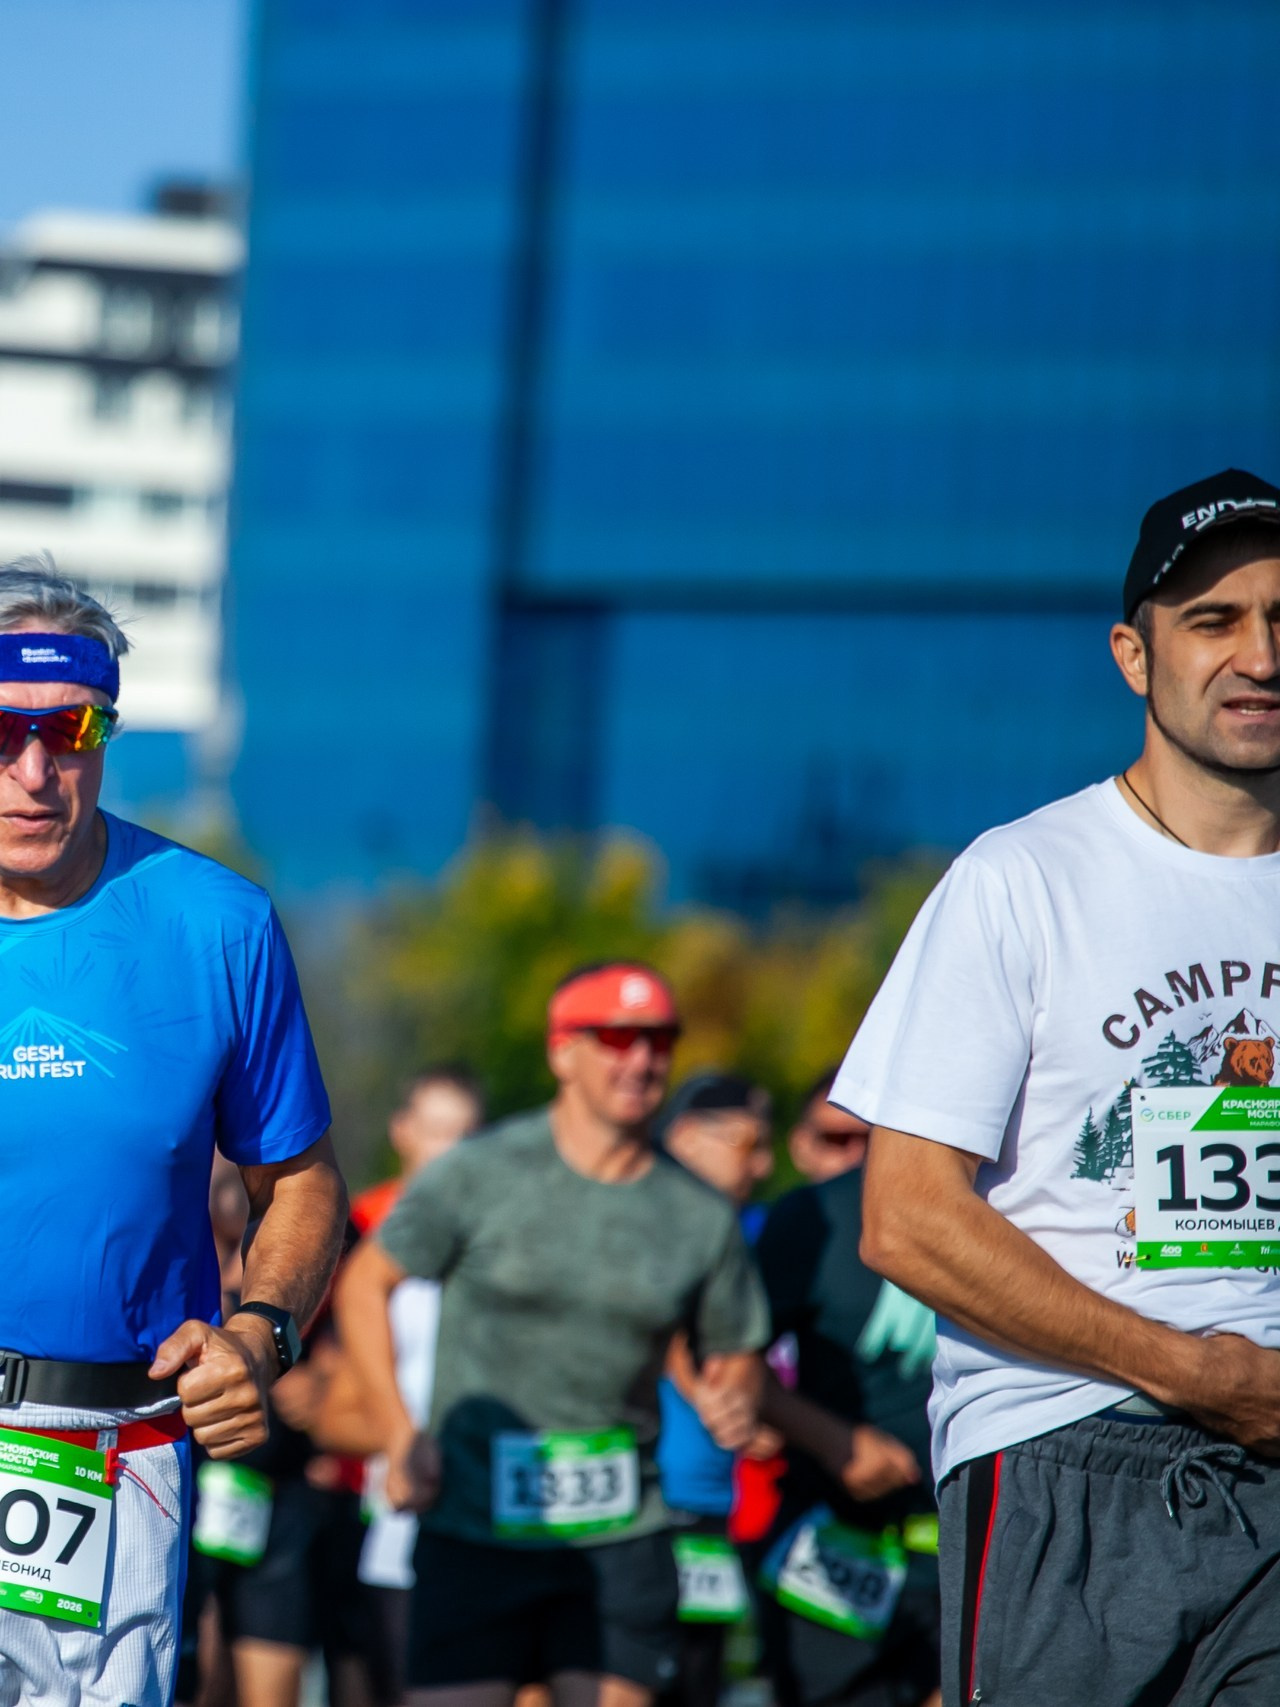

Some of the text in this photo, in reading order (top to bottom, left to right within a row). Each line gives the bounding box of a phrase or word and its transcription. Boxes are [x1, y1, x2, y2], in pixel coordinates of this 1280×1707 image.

[12, 1044, 65, 1062] GESH
[39, 1060, 87, 1079] FEST
[1157, 1110, 1192, 1121] СБЕР
[1247, 1109, 1280, 1119] МОСТ
[1175, 1218, 1275, 1232] КОЛОМЫЦЕВ
[74, 1466, 103, 1483] 10 КМ
[56, 1598, 83, 1613] 2026
